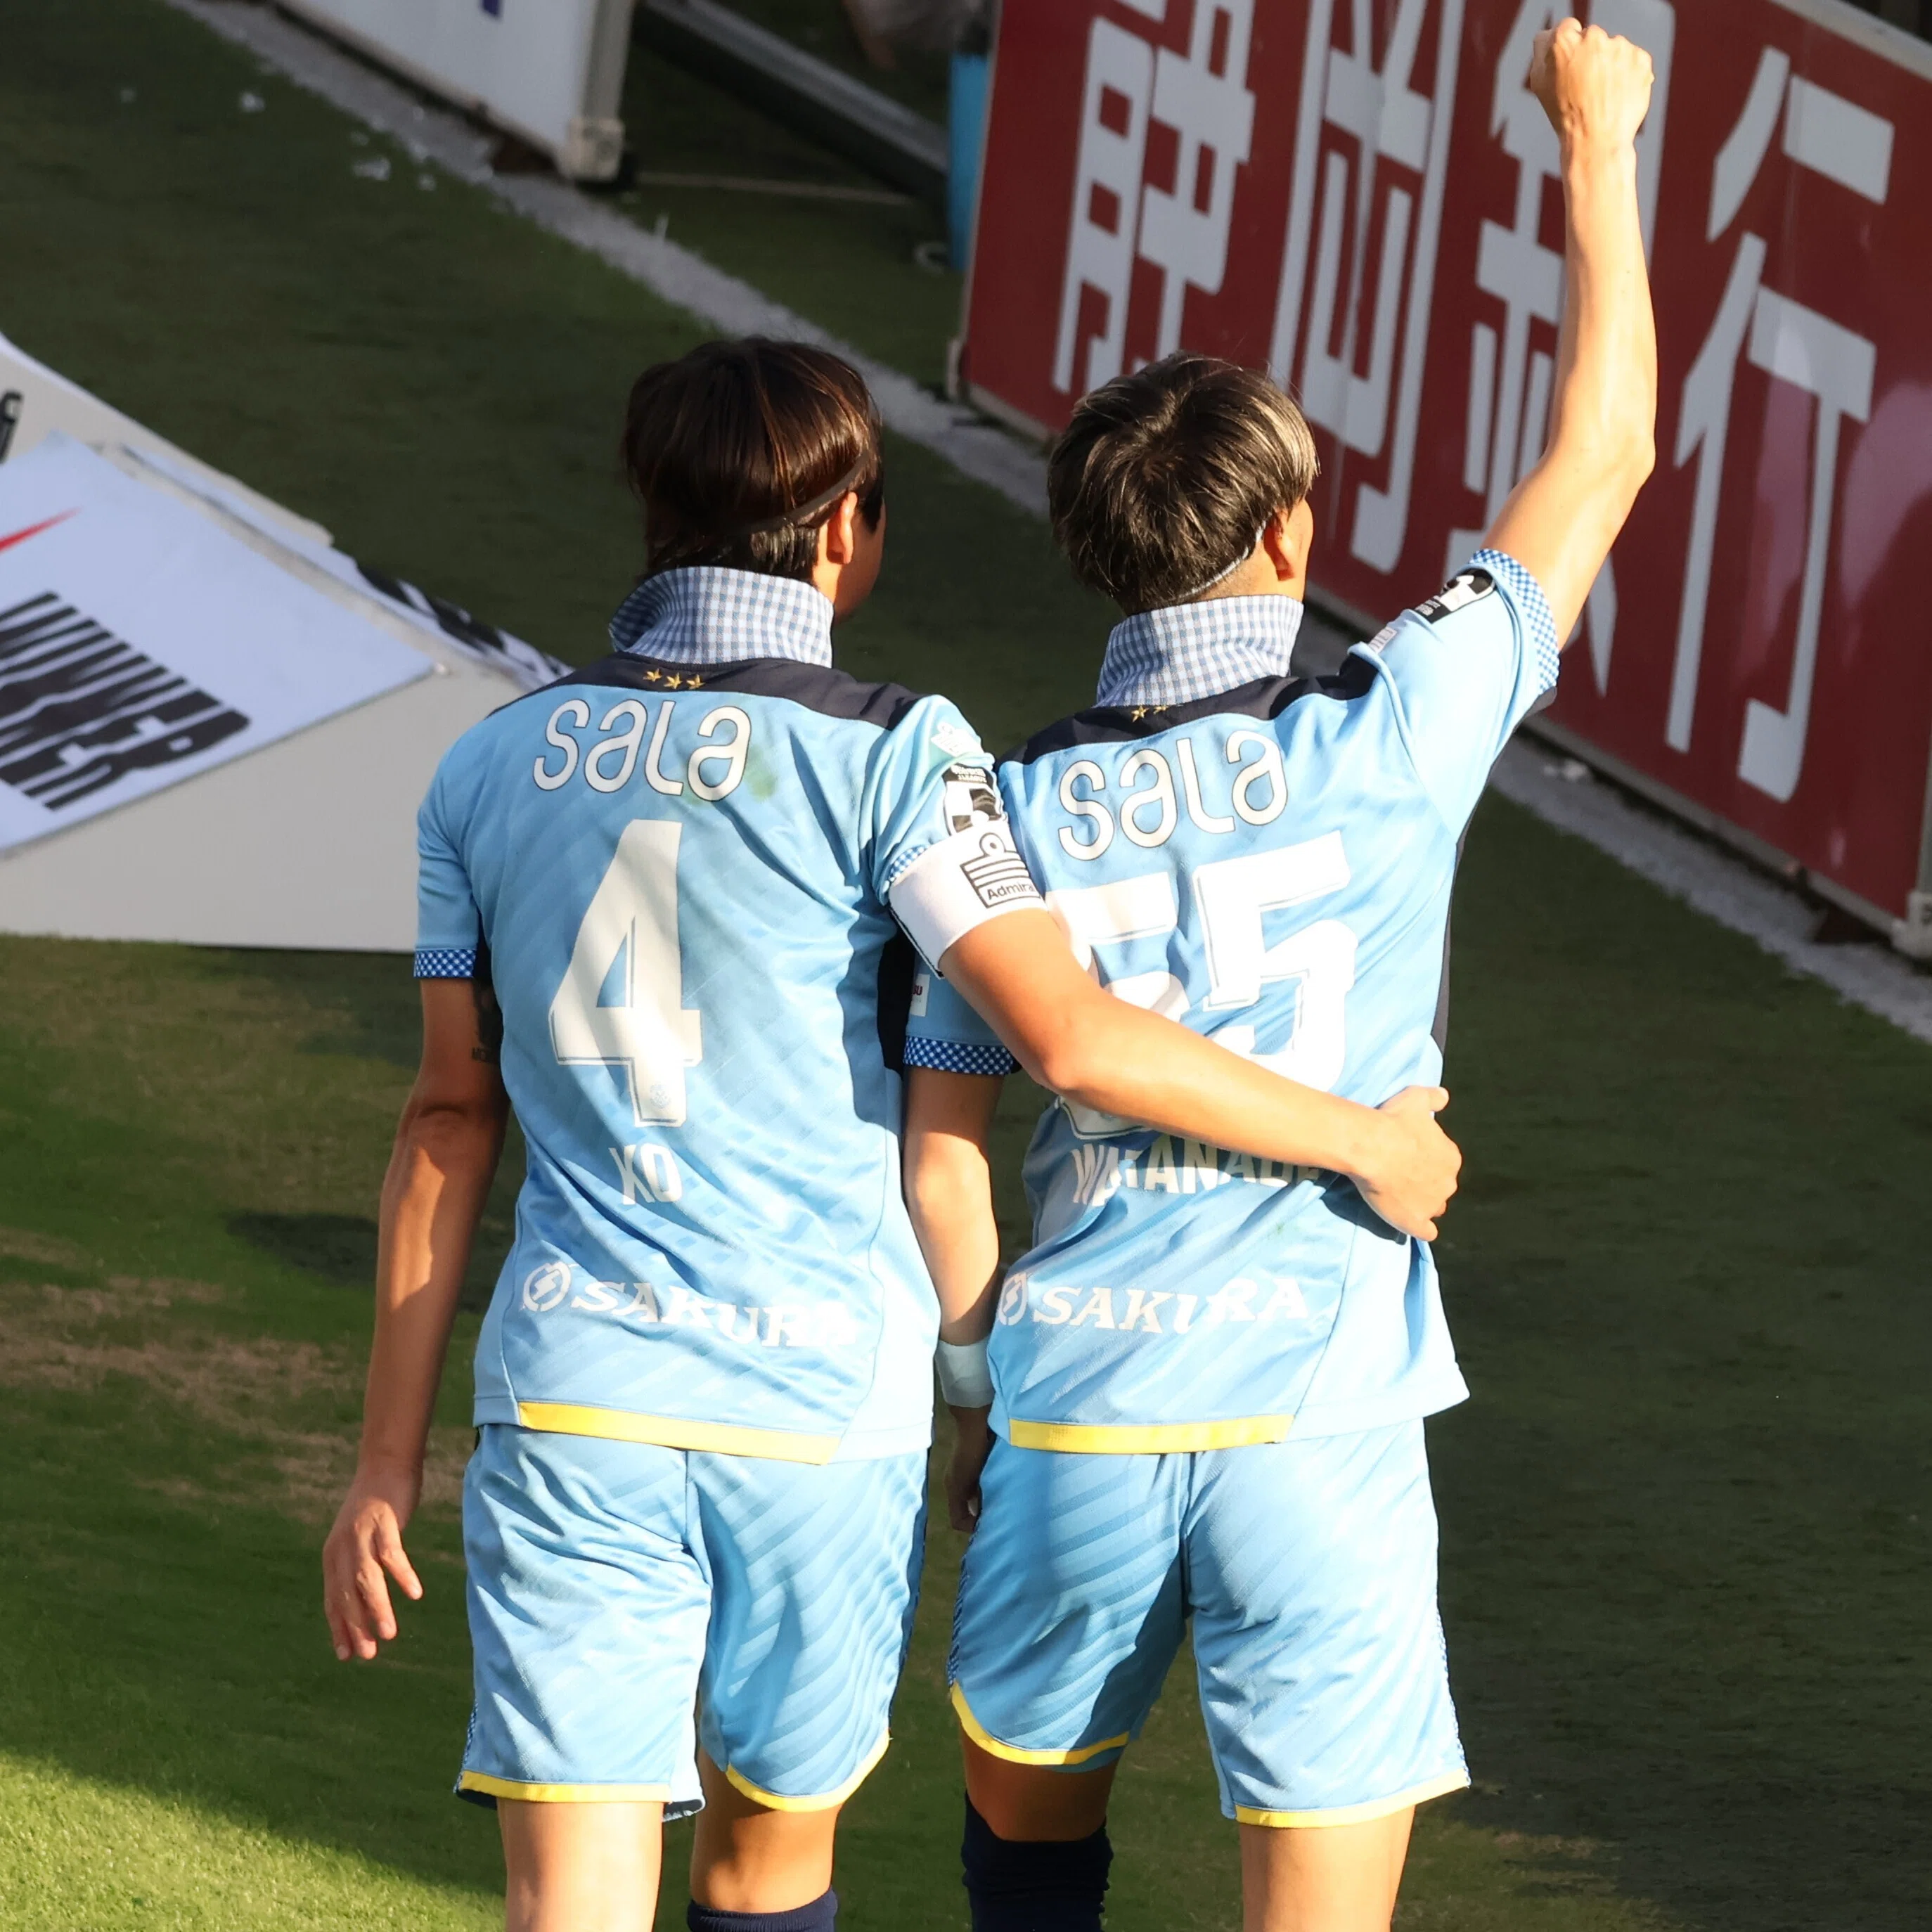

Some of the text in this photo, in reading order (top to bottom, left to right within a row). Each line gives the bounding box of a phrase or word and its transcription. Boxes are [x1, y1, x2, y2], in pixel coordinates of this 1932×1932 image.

[986, 882, 1037, 900] Admira
[548, 818, 703, 1128] 4
[608, 1142, 683, 1205] KO
[571, 1280, 856, 1347] SAKURA
